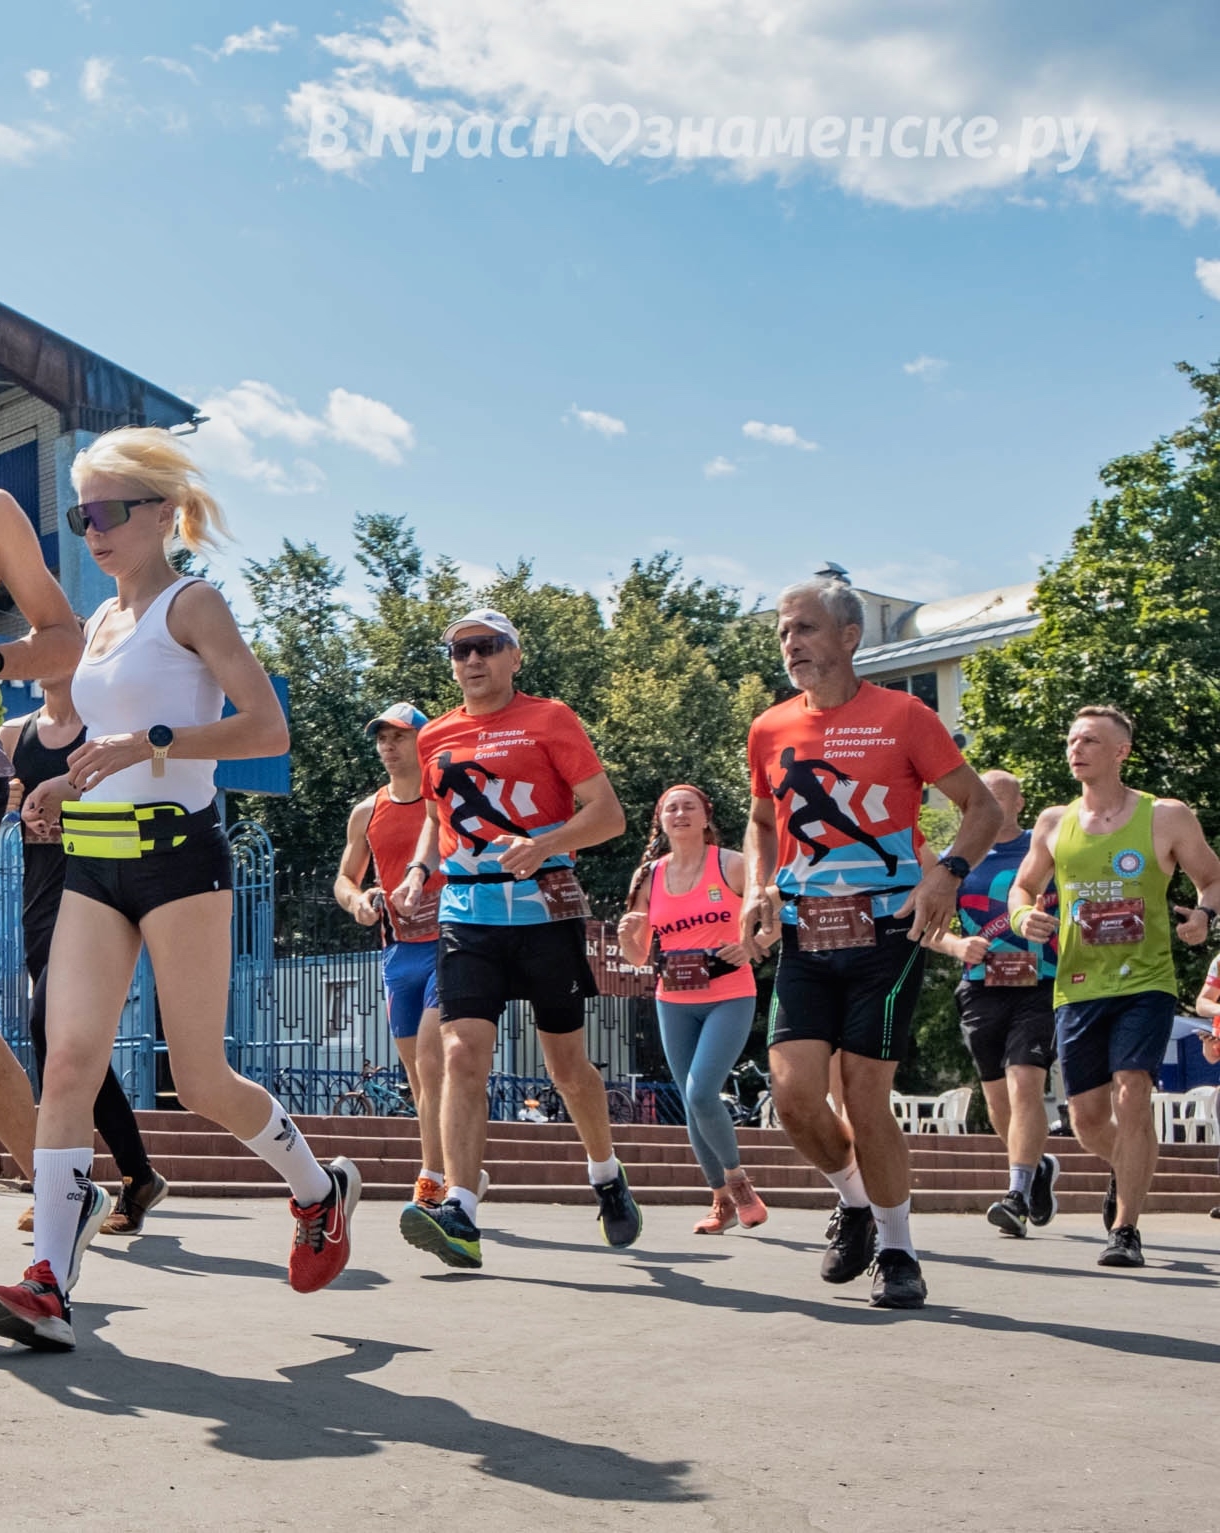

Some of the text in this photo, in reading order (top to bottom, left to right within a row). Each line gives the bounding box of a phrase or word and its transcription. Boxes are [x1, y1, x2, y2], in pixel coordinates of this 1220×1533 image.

[824, 726, 882, 736] И звезды
[823, 738, 896, 747] становятся
[823, 751, 865, 759] ближе
[606, 960, 618, 972] 11
